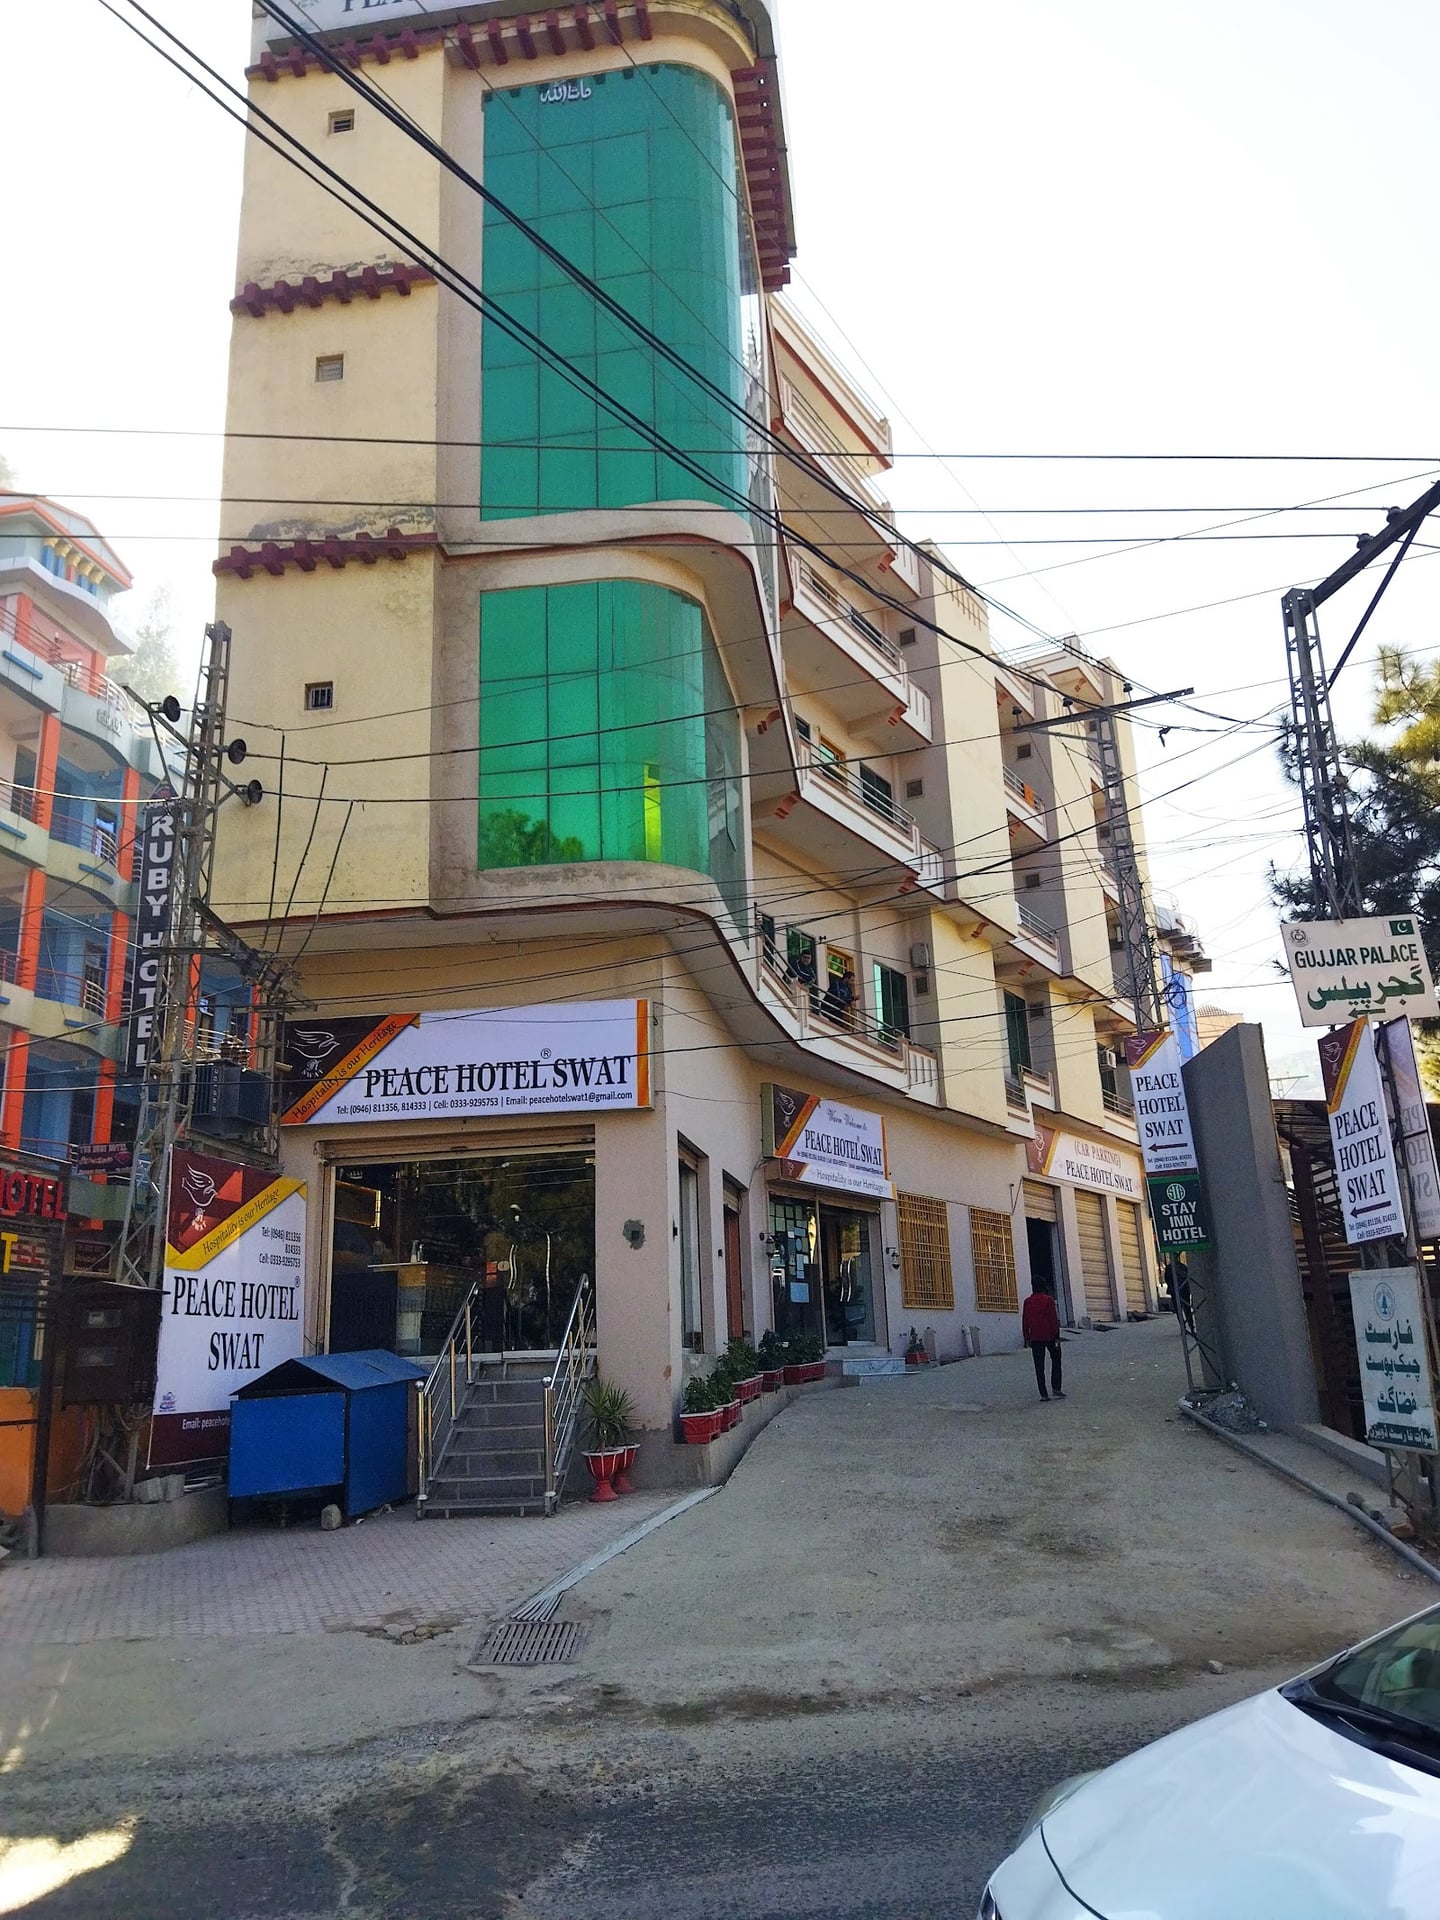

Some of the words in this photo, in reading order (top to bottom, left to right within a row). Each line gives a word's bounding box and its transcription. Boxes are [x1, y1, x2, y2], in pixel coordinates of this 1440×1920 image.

[1294, 948, 1358, 969] GUJJAR
[1360, 943, 1420, 965] PALACE
[1373, 964, 1425, 1006] گجر
[291, 1074, 340, 1119] Hospitality
[337, 1069, 347, 1080] is
[346, 1053, 362, 1069] our
[360, 1020, 398, 1056] Heritage
[363, 1065, 449, 1098] PEACE
[454, 1059, 547, 1092] HOTEL
[553, 1055, 632, 1089] SWAT
[1135, 1072, 1180, 1093] PEACE
[336, 1105, 349, 1115] Tel:
[350, 1103, 372, 1115] (0946)
[372, 1103, 400, 1113] 811356,
[401, 1101, 427, 1111] 814333
[433, 1100, 449, 1109] Cell:
[449, 1097, 499, 1109] 0333-9295753
[505, 1095, 528, 1106] Email:
[529, 1091, 633, 1106] peacehotelswat1@gmail.com
[1138, 1096, 1185, 1116] HOTEL
[1334, 1100, 1379, 1140] PEACE
[1144, 1118, 1184, 1139] SWAT
[804, 1128, 832, 1154] PEACE
[832, 1136, 861, 1161] HOTEL
[860, 1142, 882, 1167] SWAT
[1338, 1134, 1386, 1172] HOTEL
[816, 1168, 847, 1188] Hospitality
[1065, 1159, 1090, 1181] PEACE
[1090, 1166, 1114, 1188] HOTEL
[1113, 1173, 1133, 1193] SWAT
[1346, 1168, 1386, 1204] SWAT
[202, 1219, 238, 1255] Hospitality
[237, 1215, 245, 1226] is
[244, 1208, 256, 1221] our
[254, 1189, 279, 1212] Heritage
[1161, 1200, 1197, 1216] STAY
[1169, 1214, 1194, 1228] INN
[1162, 1226, 1207, 1242] HOTEL
[171, 1275, 235, 1317] PEACE
[240, 1282, 299, 1321] HOTEL
[207, 1331, 265, 1372] SWAT
